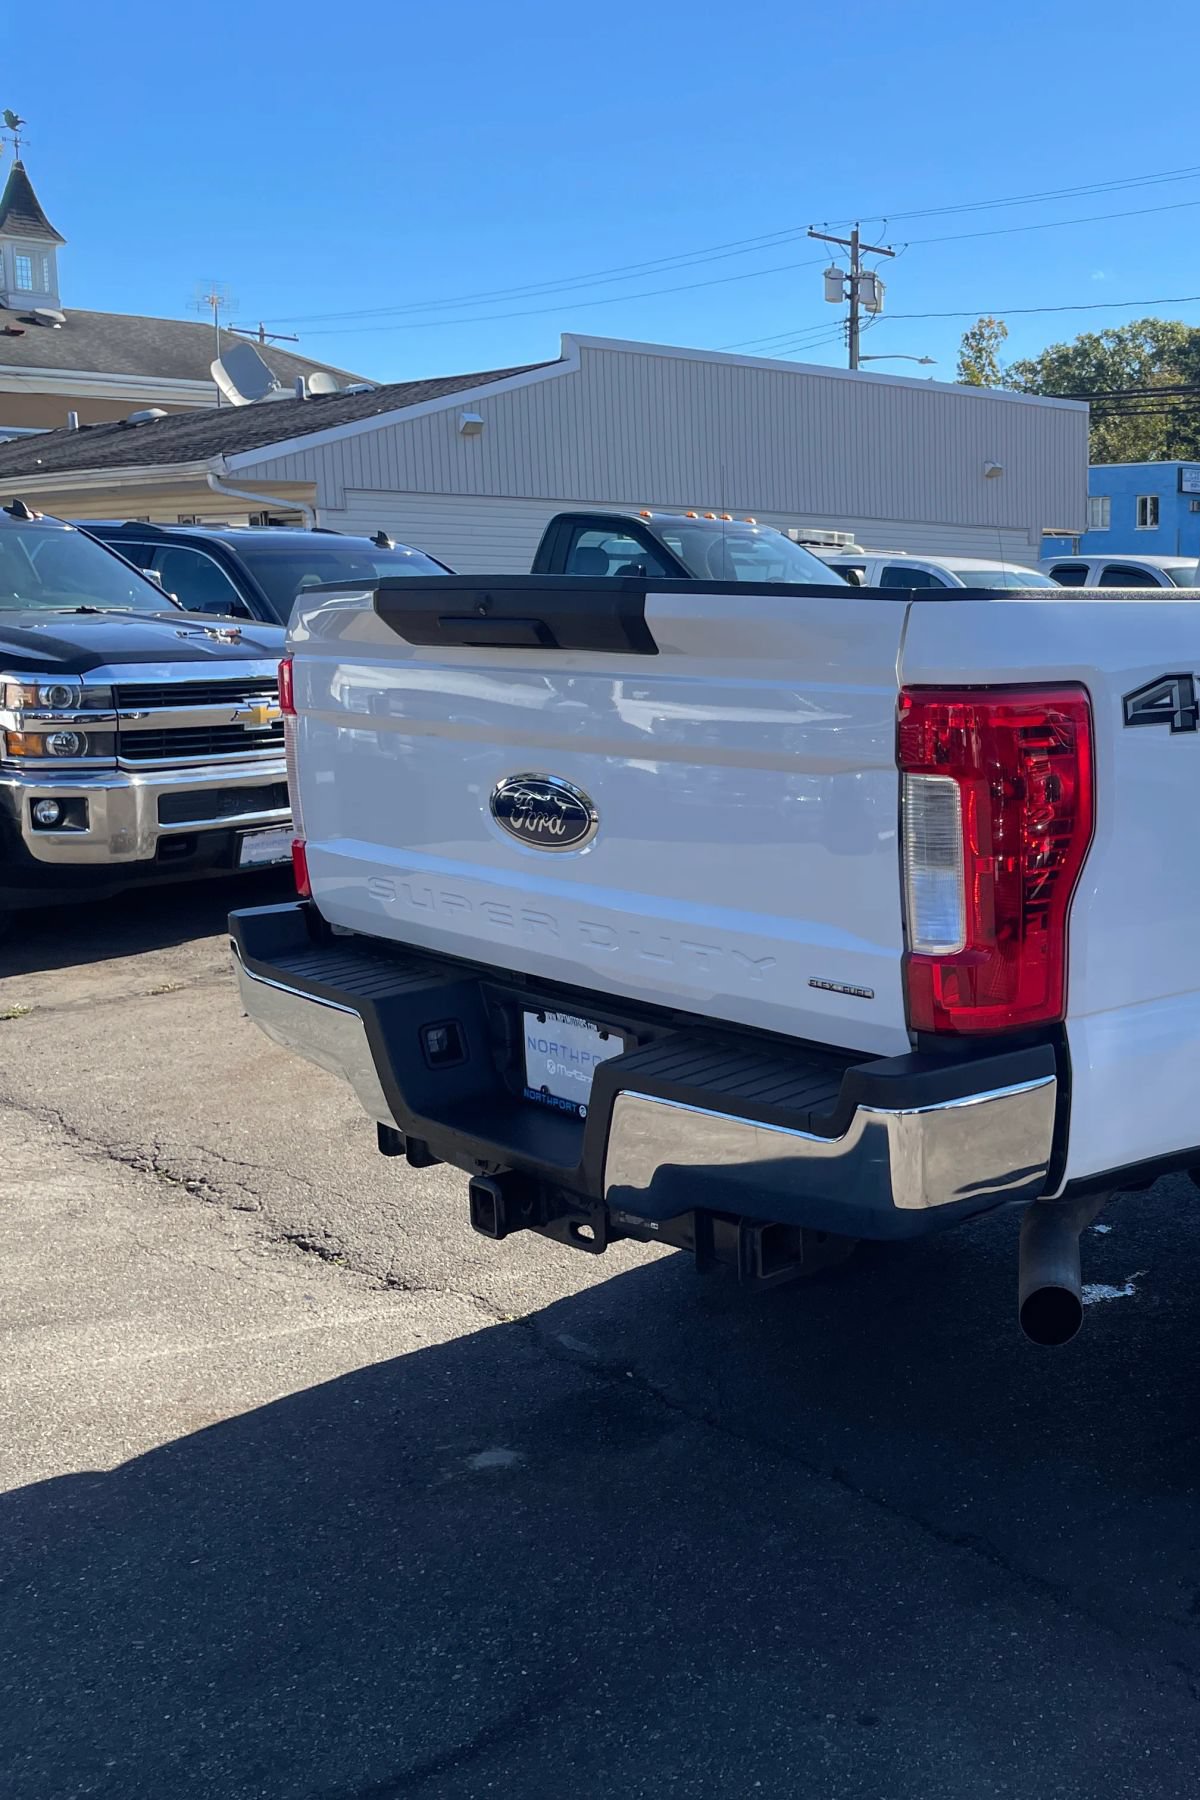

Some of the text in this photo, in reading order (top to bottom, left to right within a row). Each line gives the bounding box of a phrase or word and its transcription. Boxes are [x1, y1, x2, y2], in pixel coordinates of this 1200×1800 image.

[509, 792, 566, 835] Ford
[368, 875, 777, 982] SUPER DUTY
[527, 1035, 602, 1067] NORTHPO
[523, 1088, 578, 1113] NORTHPORT
